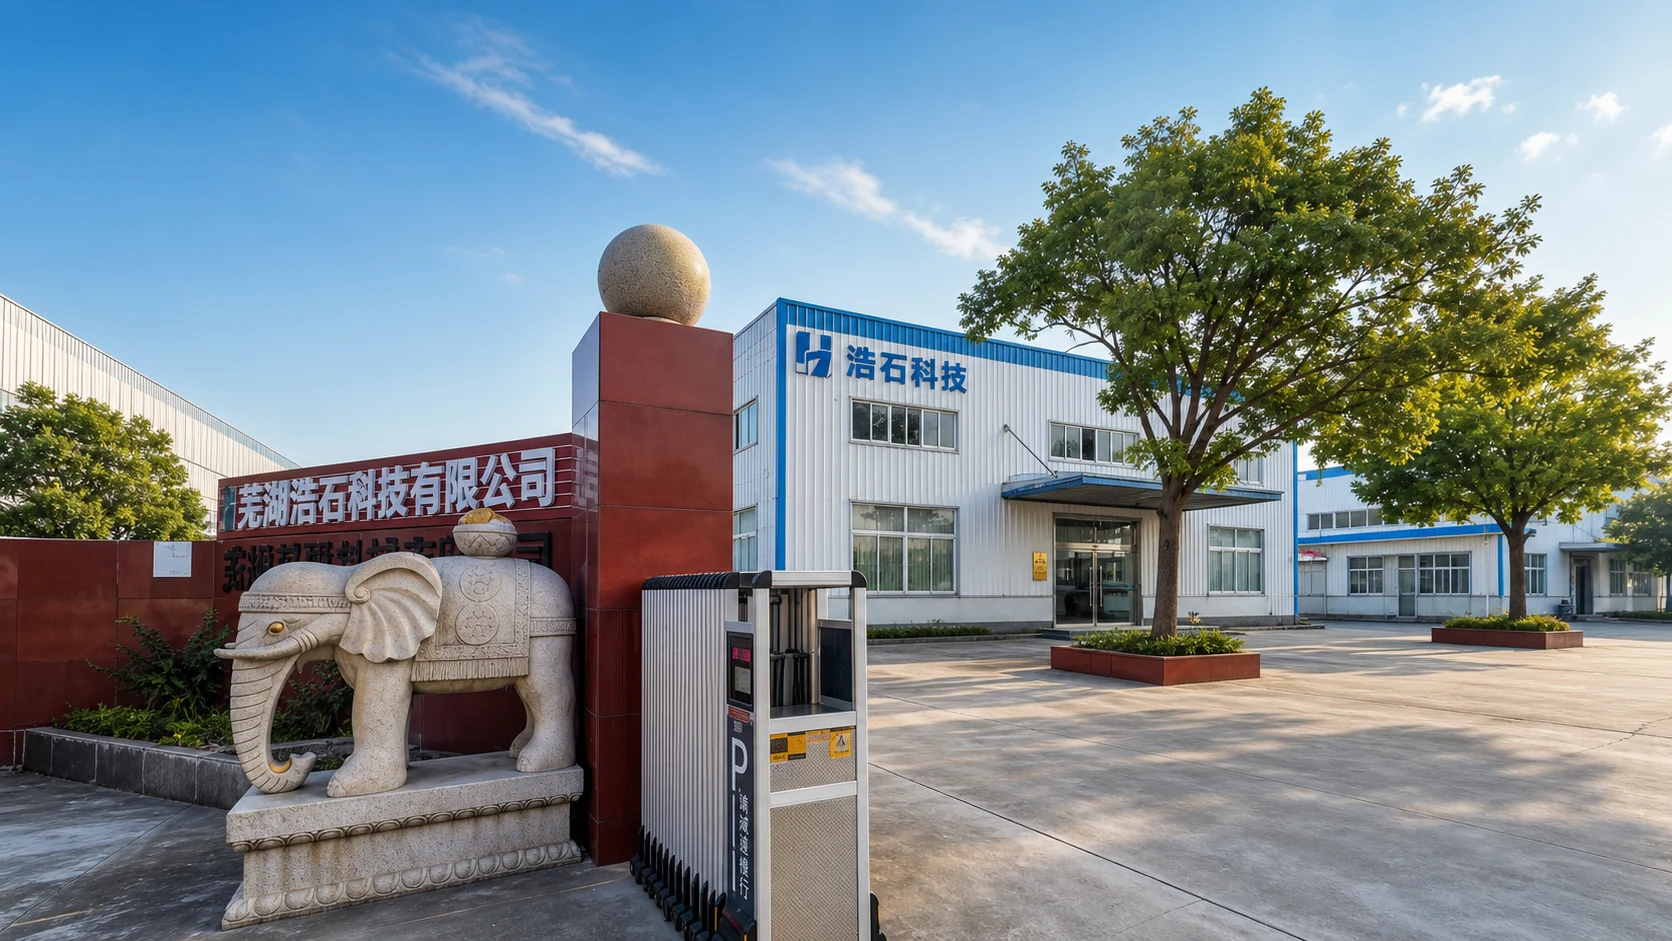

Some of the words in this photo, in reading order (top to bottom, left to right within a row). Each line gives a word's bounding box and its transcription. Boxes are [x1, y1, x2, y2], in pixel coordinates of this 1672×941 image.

[846, 344, 967, 394] 浩石科技
[237, 447, 556, 530] 芜湖浩石科技有限公司
[731, 737, 748, 791] P
